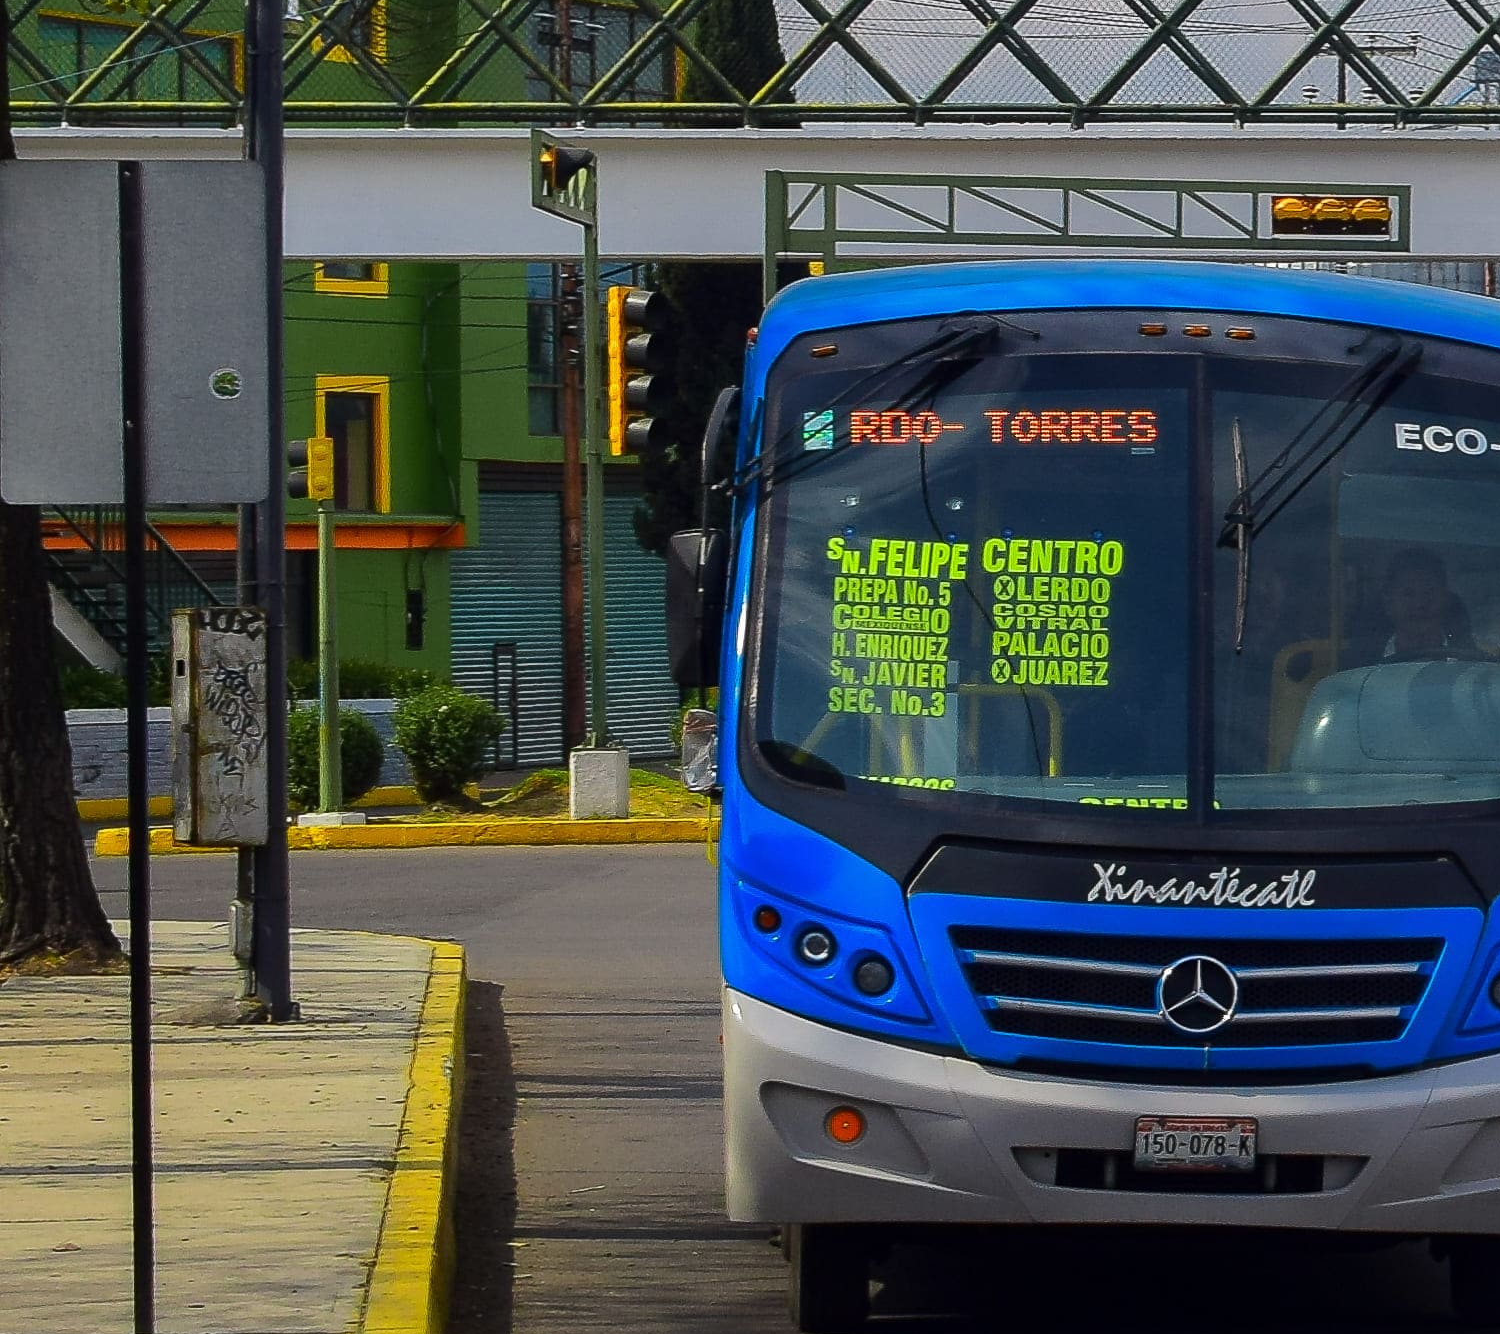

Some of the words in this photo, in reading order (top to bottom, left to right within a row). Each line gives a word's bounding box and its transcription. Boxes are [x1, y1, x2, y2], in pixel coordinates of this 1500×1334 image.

[983, 411, 1159, 445] TORRES
[982, 538, 1123, 575] CENTRO
[834, 576, 898, 604] PREPA
[938, 581, 951, 606] 5
[1017, 576, 1111, 603] LERDO
[832, 604, 950, 634] COLEGIO
[992, 605, 1109, 618] COSMO
[994, 618, 1109, 631] VITRAL
[832, 633, 850, 658] H.
[855, 634, 948, 662] ENRIQUEZ
[992, 632, 1110, 658] PALACIO
[863, 662, 946, 688] JAVIER
[1013, 662, 1109, 686] JUAREZ
[828, 687, 883, 715] SEC.
[1088, 863, 1316, 908] Xinantécatl
